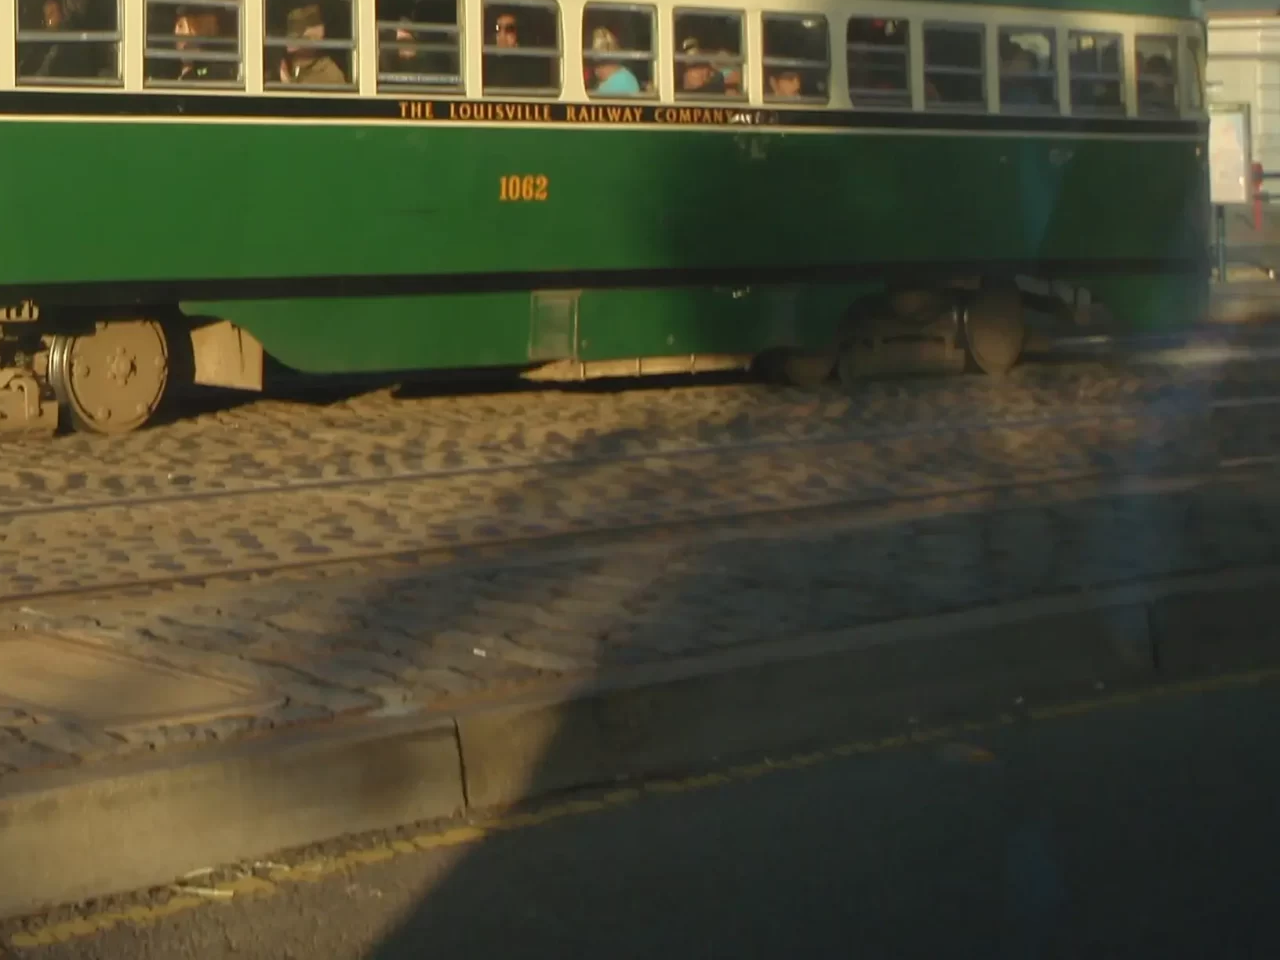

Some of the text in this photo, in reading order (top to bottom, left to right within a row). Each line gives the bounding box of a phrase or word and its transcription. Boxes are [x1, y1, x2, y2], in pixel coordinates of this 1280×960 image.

[399, 101, 733, 125] THE LOUISVILLE RAILWAY COMPANY
[498, 174, 549, 202] 1062
